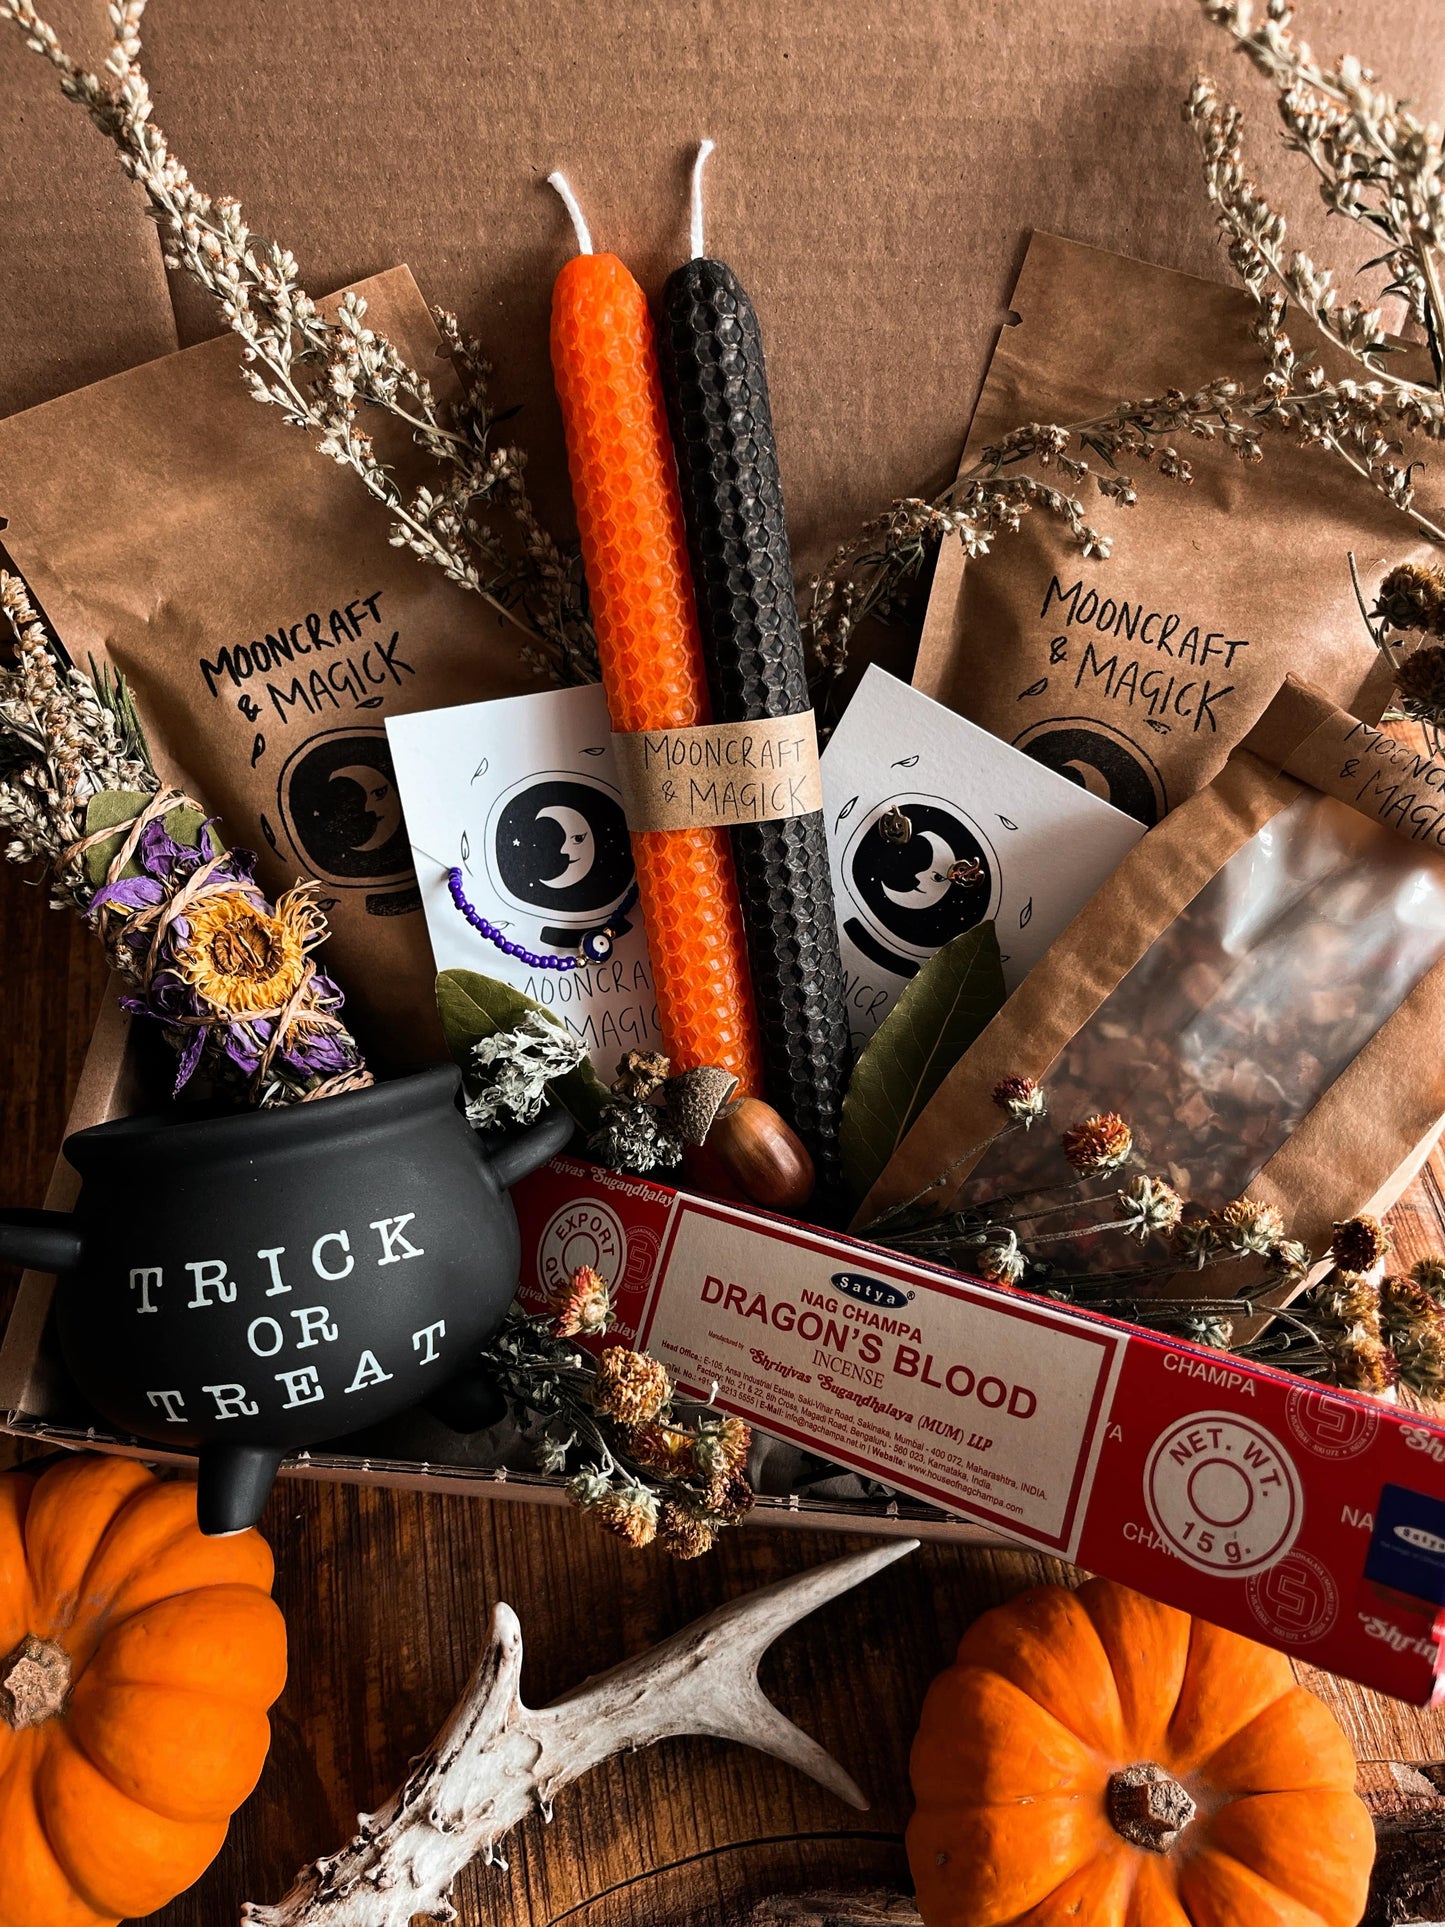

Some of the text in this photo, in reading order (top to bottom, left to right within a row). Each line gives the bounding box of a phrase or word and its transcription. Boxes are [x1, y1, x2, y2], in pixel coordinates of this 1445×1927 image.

[200, 591, 383, 697] MOONCRAFT
[1040, 575, 1249, 668] MOONCRAFT
[237, 631, 415, 724] & MAGICK
[1050, 636, 1235, 732] & MAGICK
[644, 734, 805, 770] MOONCRAFT
[1344, 722, 1445, 792] MOONC
[661, 775, 807, 819] & MAGICK
[1339, 759, 1445, 846] & MAGIC
[564, 1005, 662, 1049] MAGIC
[550, 1157, 674, 1208] inivas Sugandhalay
[129, 1212, 425, 1314] TRICK
[555, 1213, 614, 1256] EXPORT
[247, 1305, 339, 1357] OR
[700, 1275, 883, 1364] DRAGON'S
[892, 1344, 1037, 1420] BLOOD
[800, 1289, 923, 1344] NAG CHAMPA
[146, 1319, 447, 1423] TREAT
[749, 1347, 993, 1452] Shrinivas Sugandhalaya (MUM) LLP
[811, 1350, 885, 1390] INCENSE
[1163, 1353, 1256, 1397] CHAMPA
[661, 1339, 679, 1352] Head
[703, 1356, 723, 1372] E-105,
[724, 1365, 741, 1378] Ansa
[742, 1371, 772, 1390] Industrial
[772, 1383, 795, 1401] Estate,
[797, 1394, 833, 1415] Saki-Vihar
[833, 1408, 855, 1424] Road,
[856, 1417, 891, 1439] Sakinaka,
[893, 1432, 925, 1451] Mumbai
[930, 1447, 946, 1459] 400
[946, 1453, 963, 1468] 072,
[965, 1460, 1018, 1489] Maharashtra,
[1020, 1482, 1047, 1500] INDIA.
[696, 1364, 724, 1382] Factory:
[724, 1375, 736, 1386] No.
[737, 1380, 746, 1390] 21
[765, 1392, 777, 1403] 8th
[777, 1397, 799, 1413] Cross,
[800, 1406, 826, 1423] Magadi
[827, 1416, 848, 1433] Road,
[849, 1425, 887, 1448] Bengaluru
[909, 1450, 925, 1464] 023,
[927, 1457, 968, 1482] Karnataka,
[971, 1474, 992, 1490] India.
[759, 1400, 784, 1416] E-Mail:
[784, 1410, 866, 1450] info@nagchampa.net.in
[872, 1445, 906, 1467] Website:
[907, 1462, 1024, 1515] www.houseofnagchampa.com
[1169, 1428, 1232, 1466] NET.
[1242, 1440, 1282, 1497] WT.
[1123, 1522, 1179, 1559] CHA
[1340, 1505, 1374, 1533] NA
[1358, 1612, 1438, 1666] Shrin
